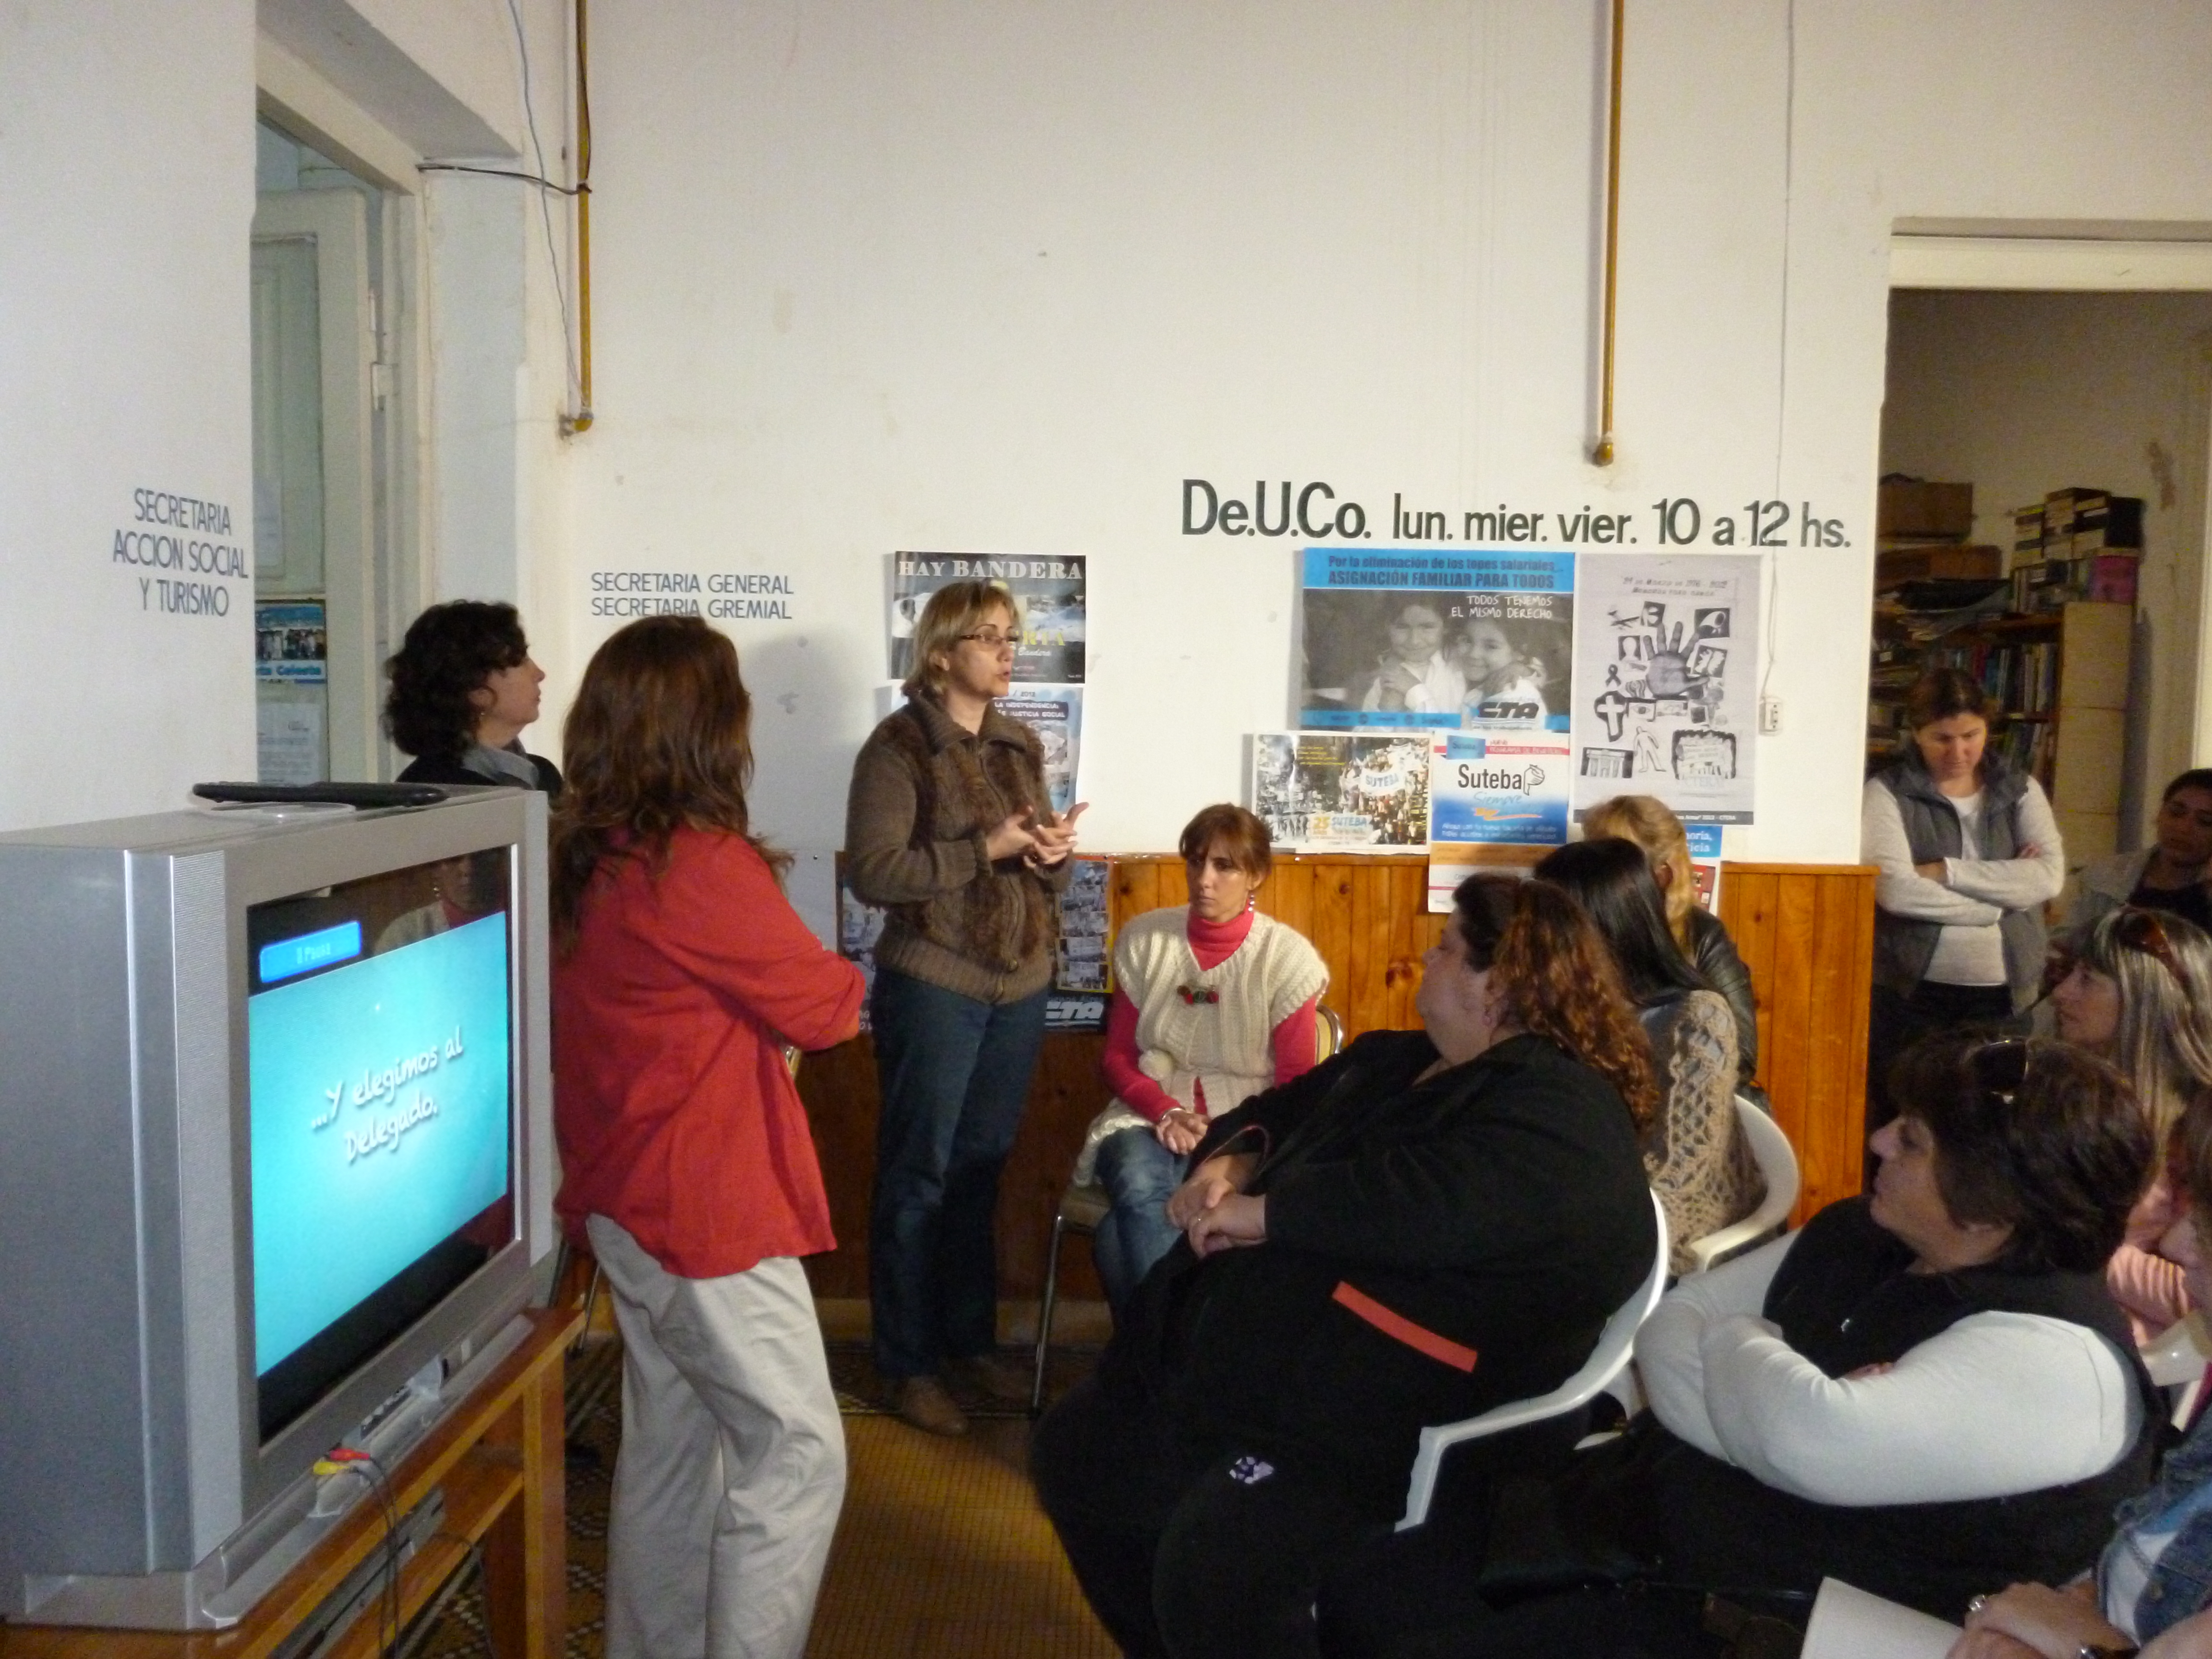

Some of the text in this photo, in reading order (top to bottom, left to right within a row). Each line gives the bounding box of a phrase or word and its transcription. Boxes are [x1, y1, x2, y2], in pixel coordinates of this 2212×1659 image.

[134, 488, 231, 536] SECRETARIA
[1182, 479, 1851, 548] De.U.Co. lun. mier. vier. 10 a 12 hs.
[113, 529, 248, 578] ACCION SOCIAL
[1329, 556, 1346, 567] Por
[1350, 556, 1359, 567] la
[1362, 557, 1428, 569] eliminación
[1431, 558, 1444, 569] de
[1448, 558, 1464, 569] los
[1467, 559, 1498, 571] topes
[898, 560, 1082, 579] HAY BANDERA
[1328, 570, 1554, 589] ASIGNACIÓN FAMILIAR PARA TODOS
[591, 572, 794, 595] SECRETARIA GENERAL
[139, 577, 149, 611] Y
[156, 579, 228, 616] TURISMO
[1467, 595, 1553, 607] TODOS TENEMOS
[591, 597, 792, 619] SECRETARIA GREMIAL
[1452, 606, 1552, 619] EL MISMO DERECHO
[1478, 701, 1539, 719] CTA
[1458, 764, 1522, 790] Suteba
[1474, 791, 1522, 805] Siempre
[353, 1046, 438, 1106] elegimos
[445, 1025, 464, 1061] al
[344, 1088, 439, 1163] Delegado.
